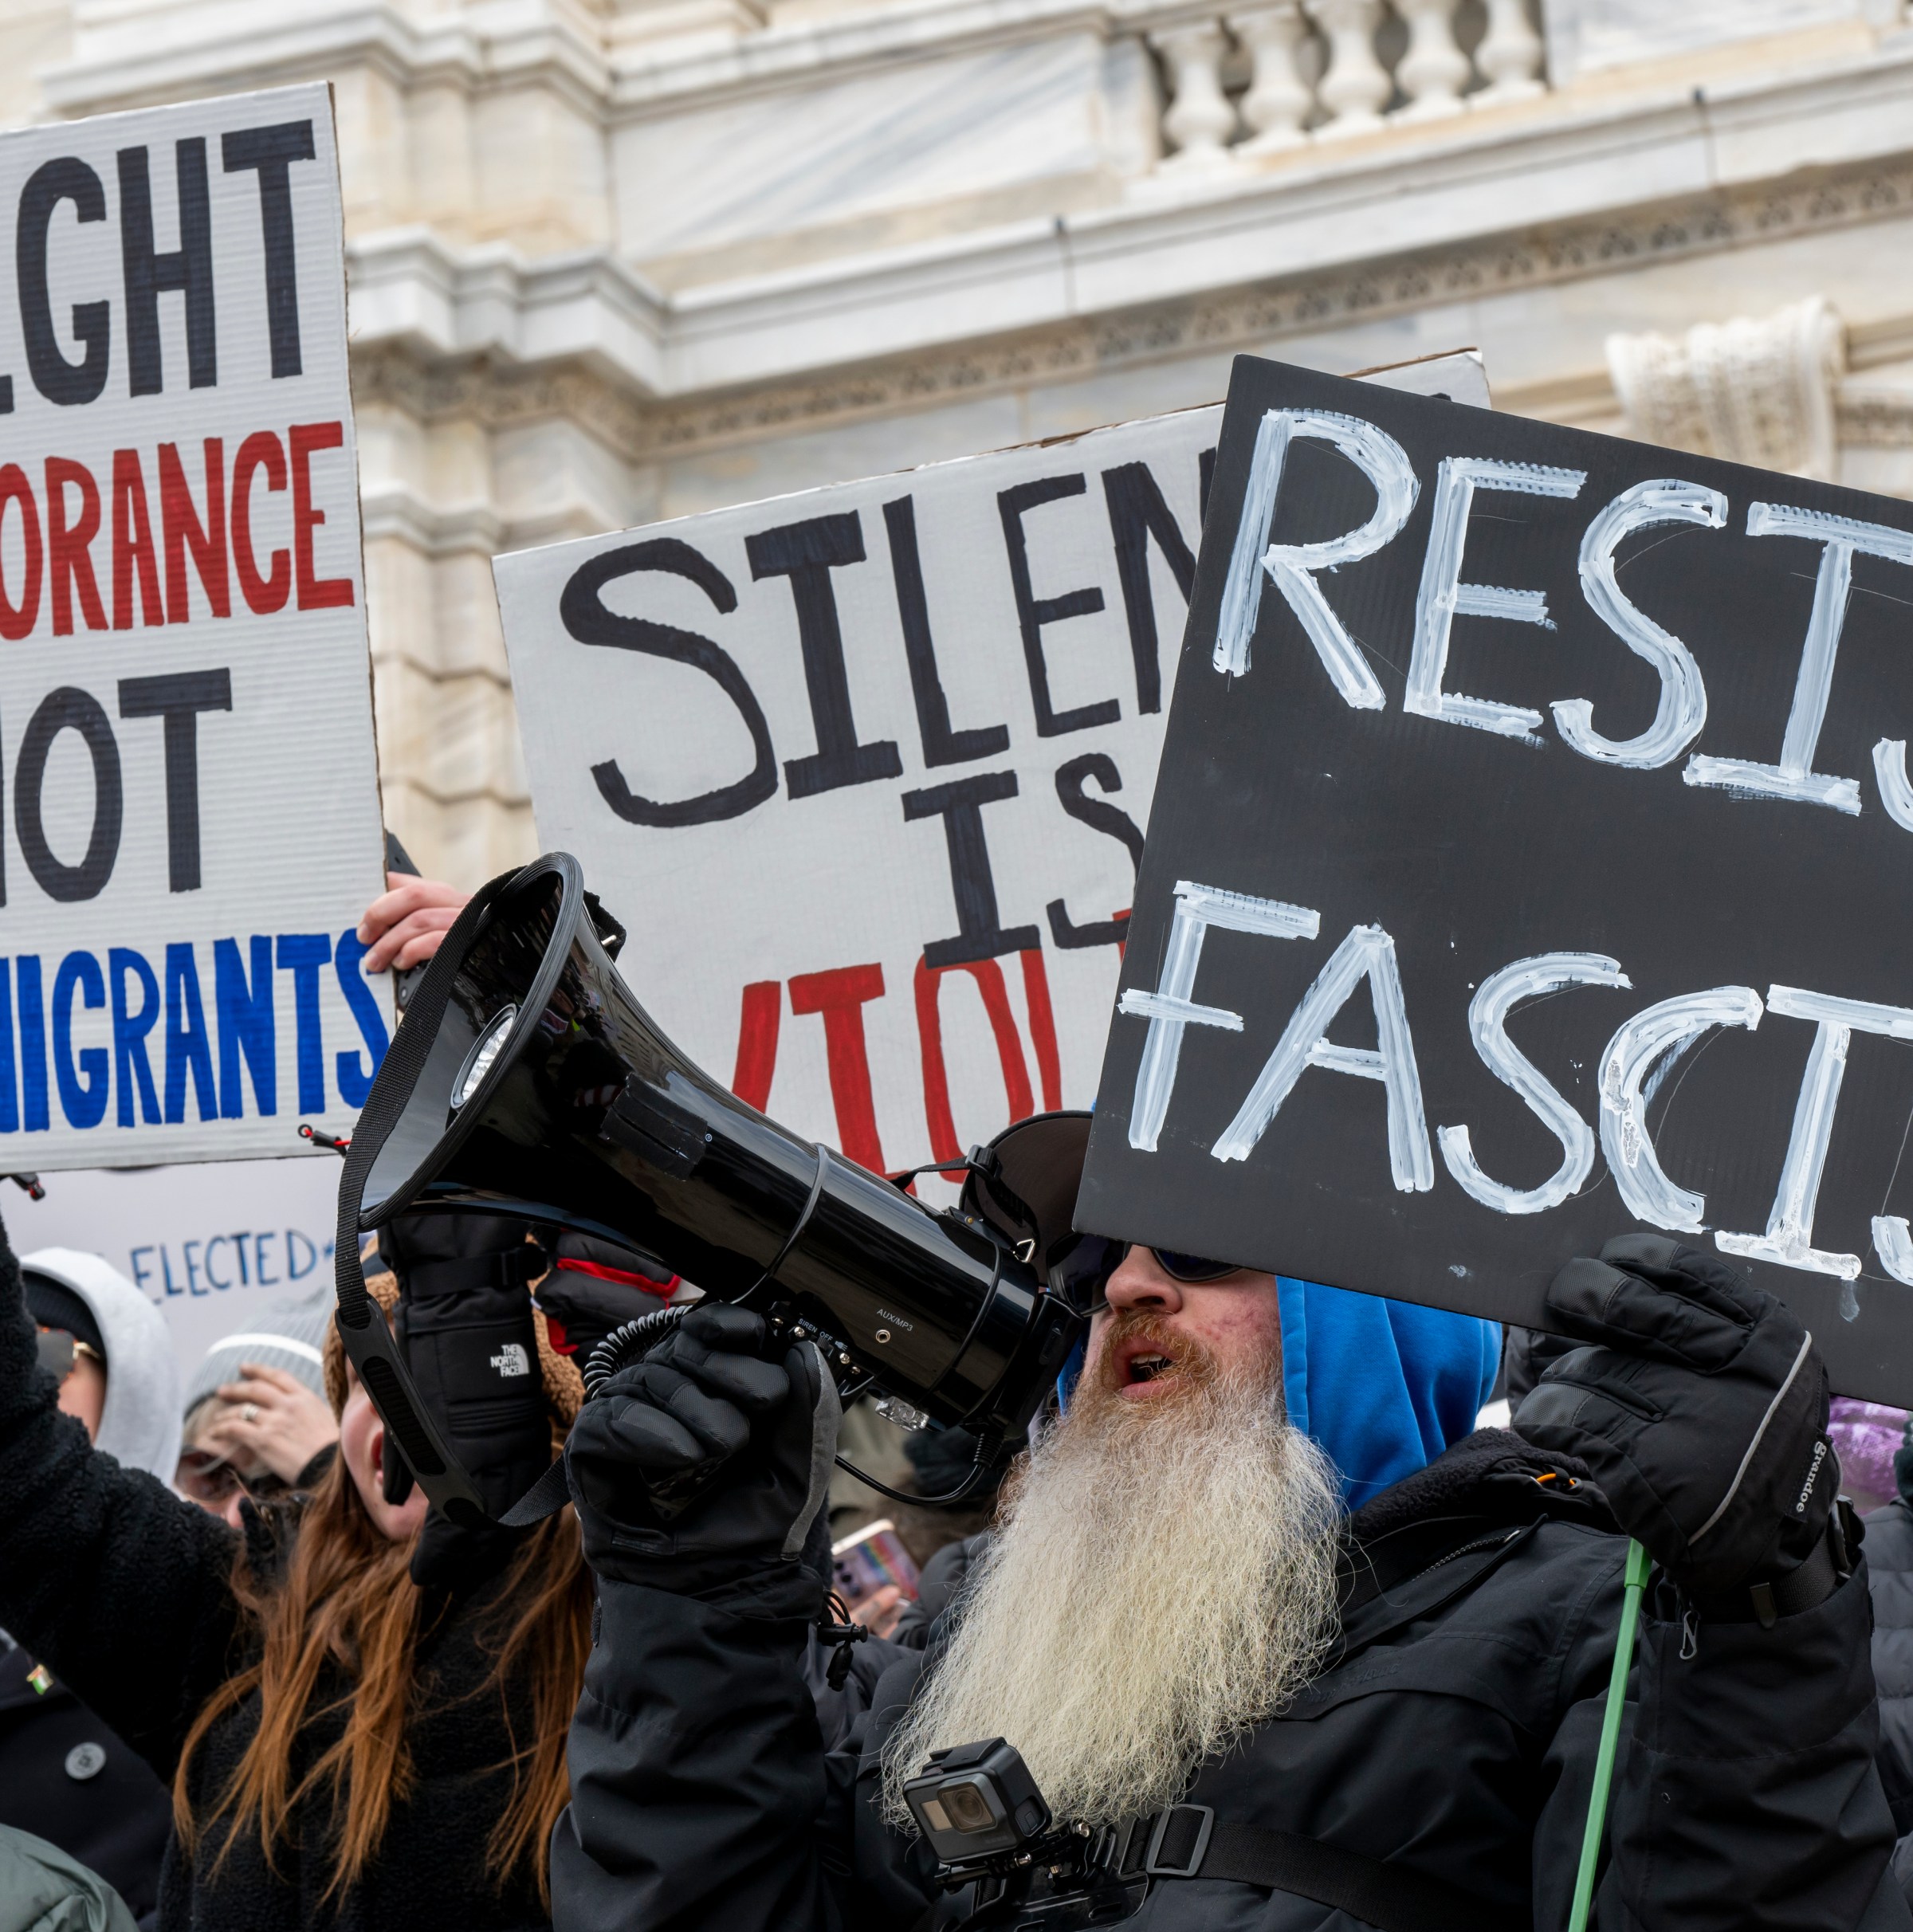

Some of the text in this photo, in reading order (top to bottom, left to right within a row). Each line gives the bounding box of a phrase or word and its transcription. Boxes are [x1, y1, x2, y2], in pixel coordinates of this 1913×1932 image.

[0, 119, 316, 414] GHT
[0, 421, 355, 638] ORANCE
[1212, 407, 1913, 833] RESI
[560, 447, 1216, 828] SILEN
[0, 667, 232, 908] OT
[902, 752, 1145, 968] IS
[0, 927, 390, 1133] IGRANTS
[1118, 880, 1913, 1286] FASCI
[129, 1227, 317, 1305] ELECTED
[490, 1356, 518, 1368] NORTH
[501, 1344, 518, 1356] THE
[798, 1317, 834, 1342] SIREN OFF
[877, 1308, 913, 1332] AUX/MP3
[500, 1366, 520, 1377] FACE
[1796, 1440, 1828, 1513] grandoe
